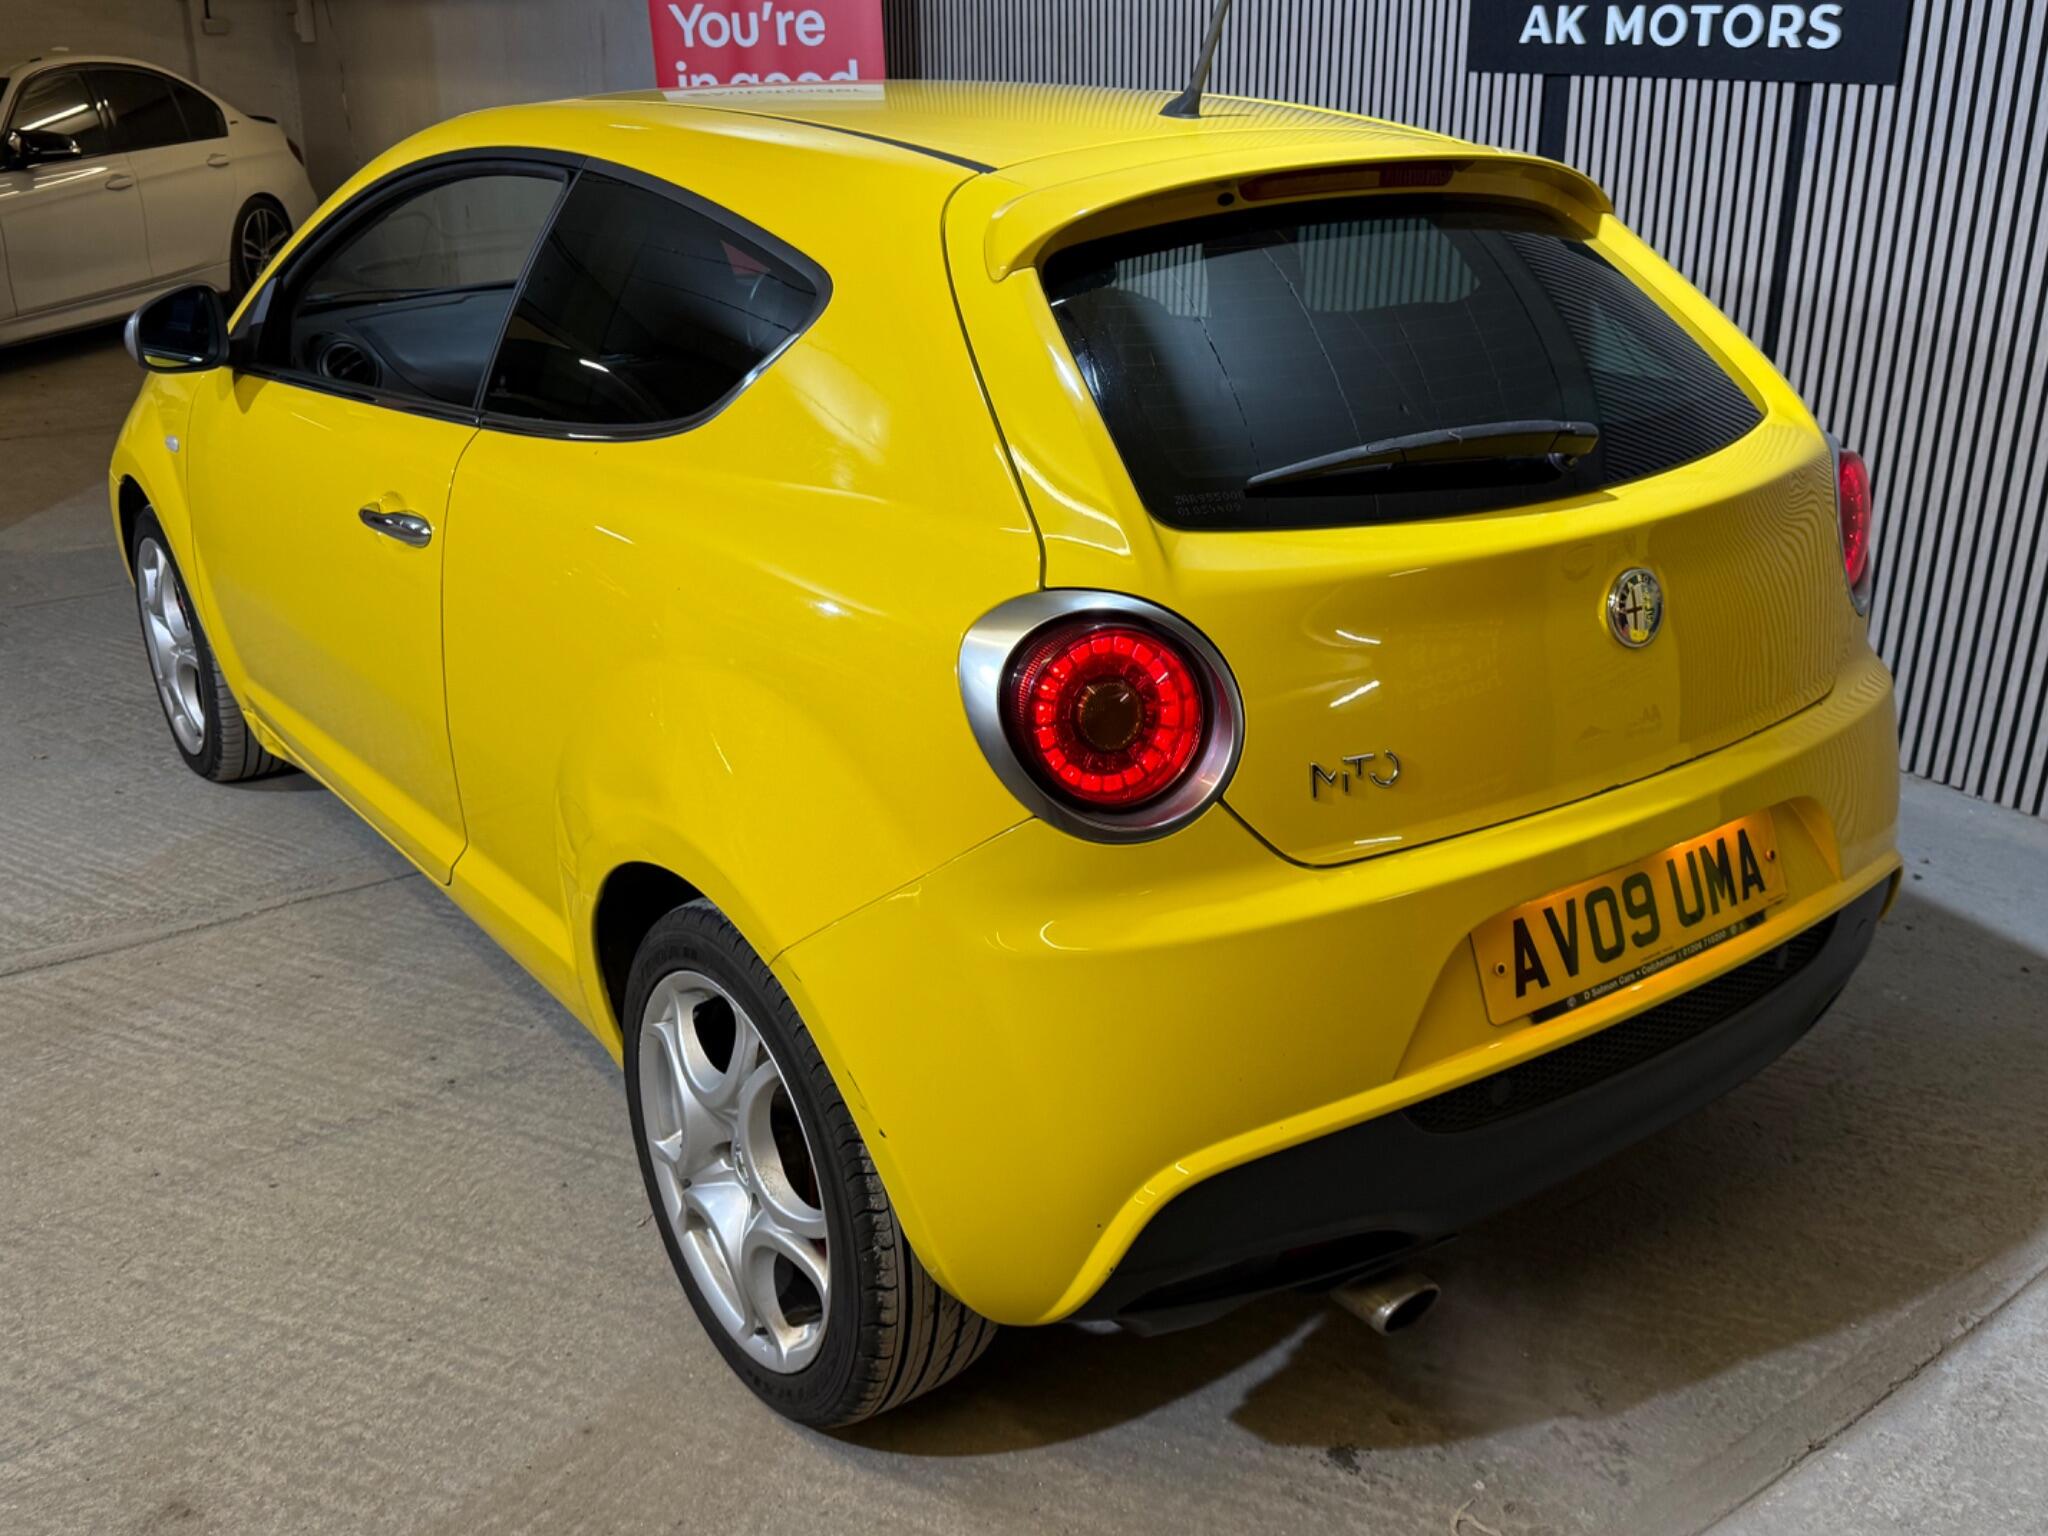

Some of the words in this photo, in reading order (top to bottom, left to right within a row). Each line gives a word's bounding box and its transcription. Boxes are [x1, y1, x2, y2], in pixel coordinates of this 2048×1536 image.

[1519, 4, 1589, 46] AK
[1604, 3, 1843, 50] MOTORS
[1512, 871, 1661, 999] AV09
[1666, 828, 1766, 929] UMA
